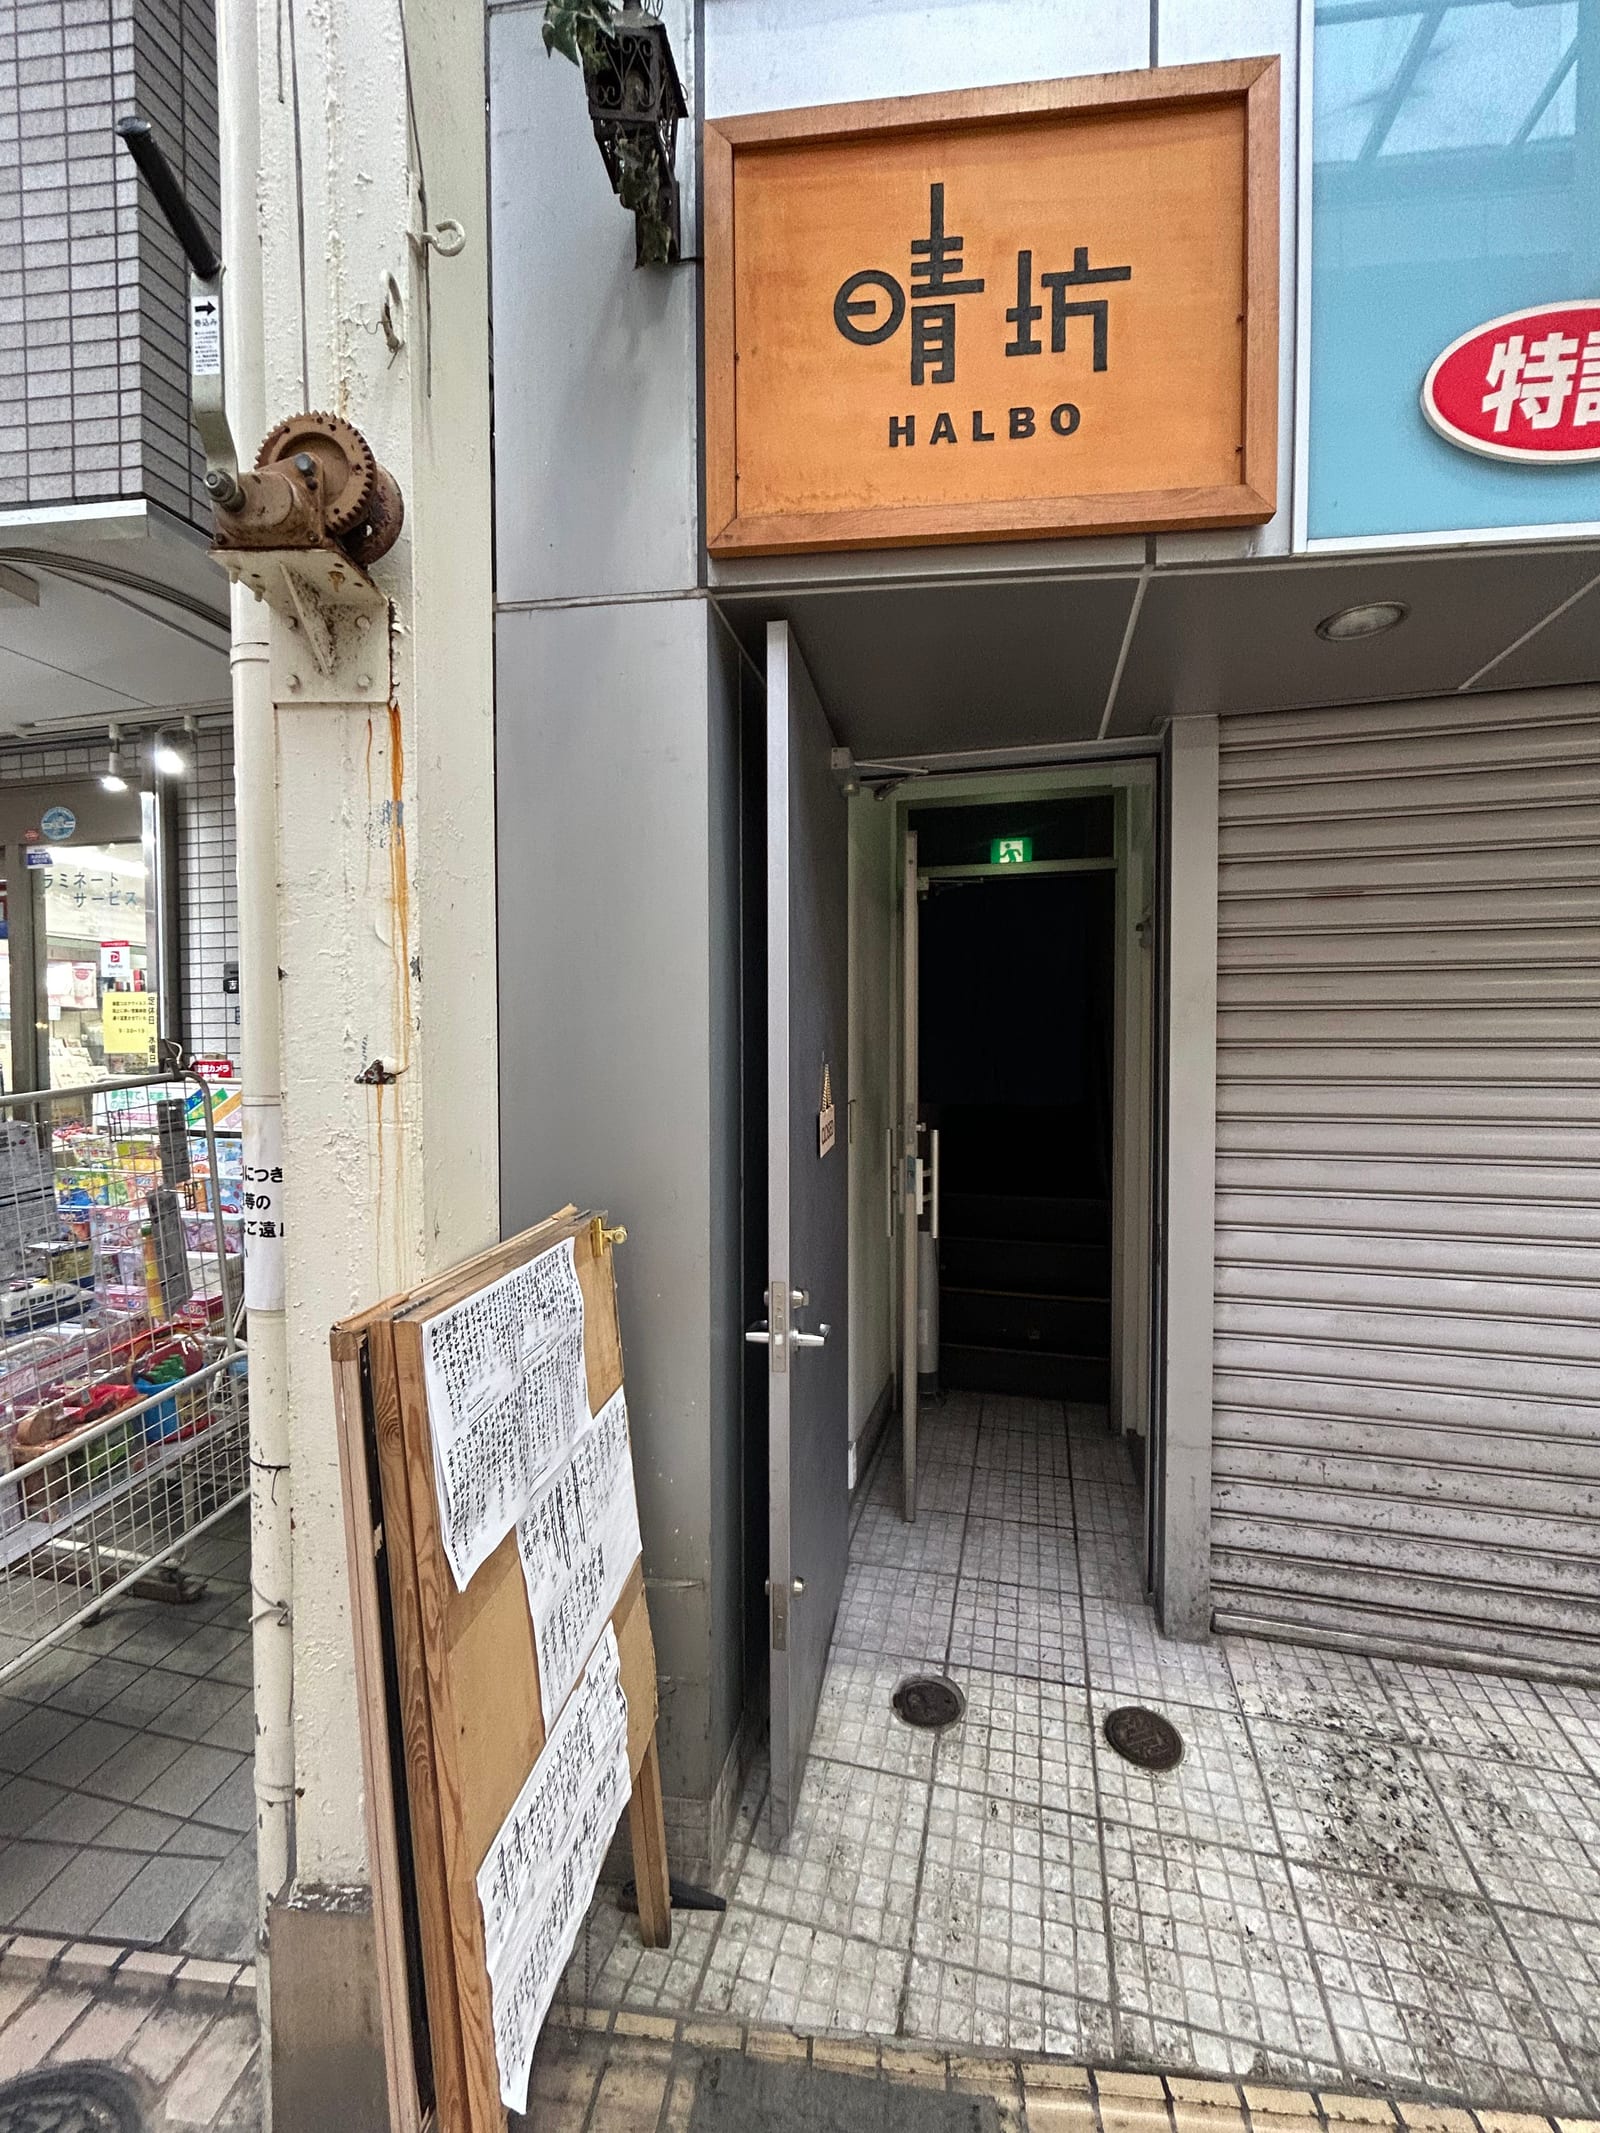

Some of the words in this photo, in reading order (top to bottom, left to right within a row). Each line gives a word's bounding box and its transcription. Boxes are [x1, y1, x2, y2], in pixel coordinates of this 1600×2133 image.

[888, 402, 1081, 447] HALBO
[43, 871, 119, 888] ラミネート
[73, 889, 138, 908] サービス
[147, 996, 156, 1025] 定休日
[148, 1036, 157, 1064] 水曜日
